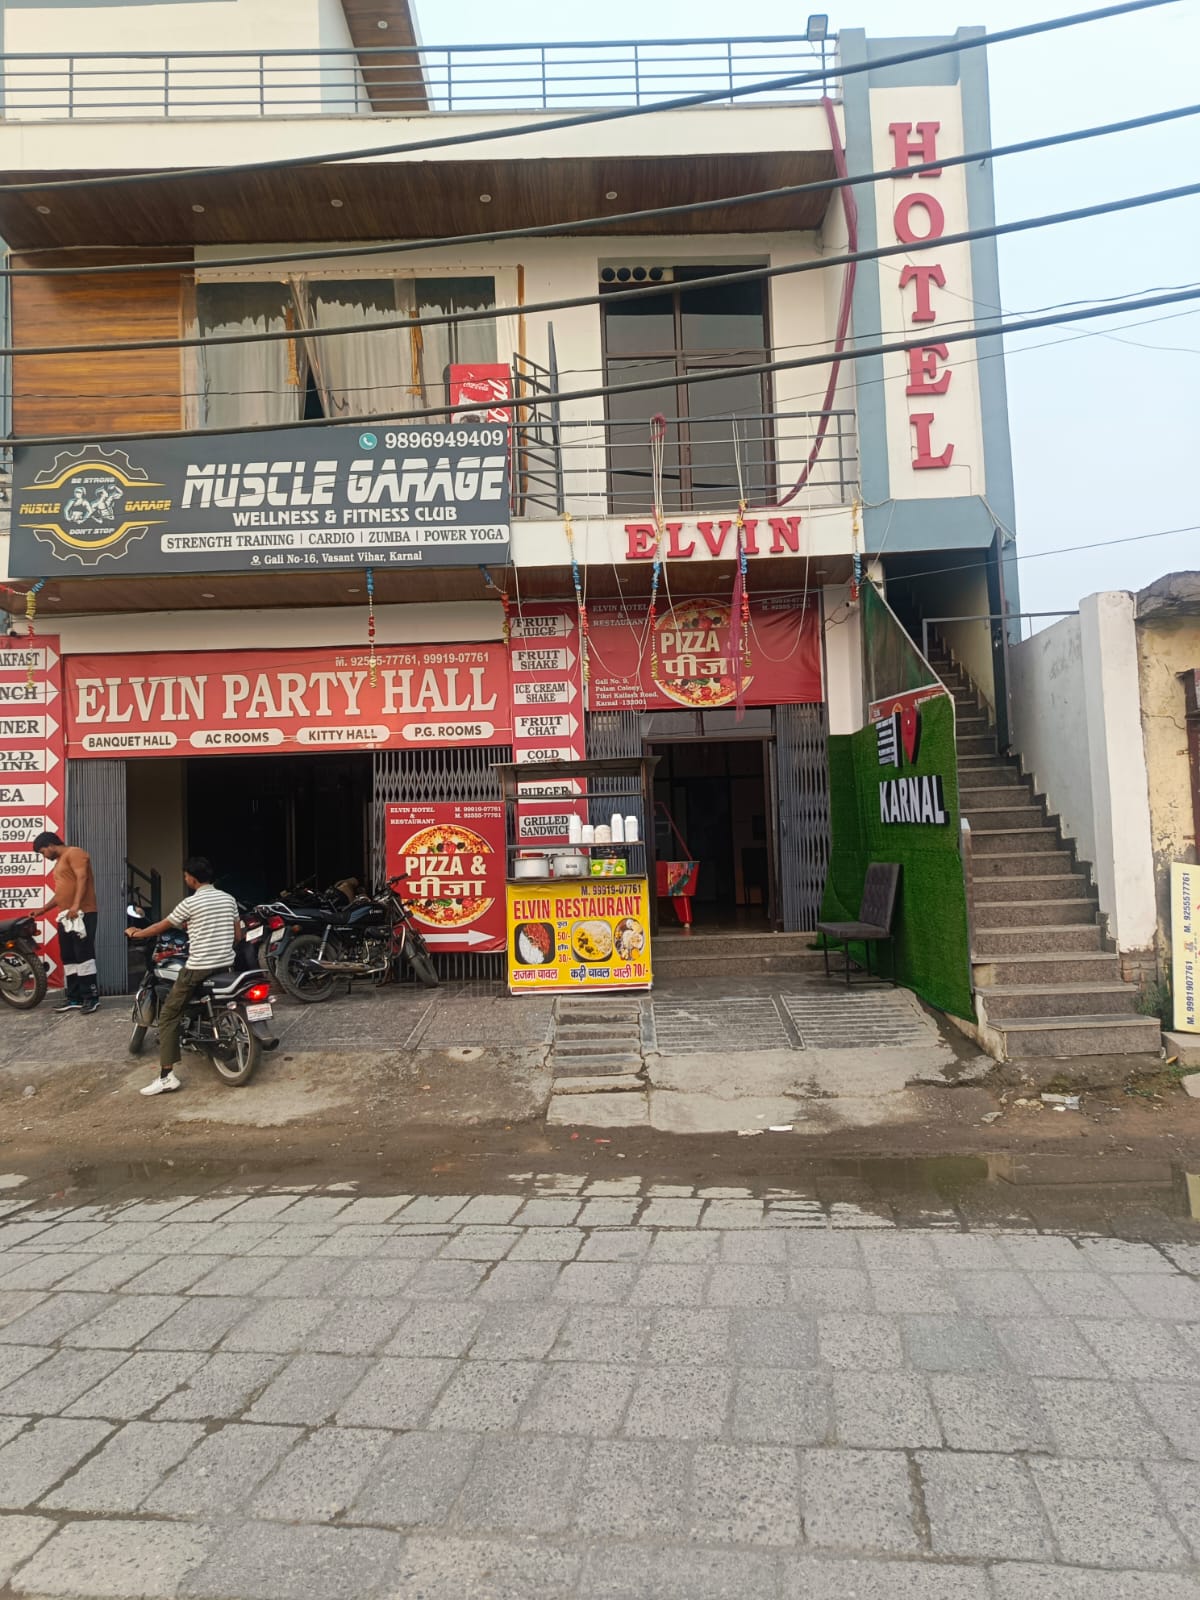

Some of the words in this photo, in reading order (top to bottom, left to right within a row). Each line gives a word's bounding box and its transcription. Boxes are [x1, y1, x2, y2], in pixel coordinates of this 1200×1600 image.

[889, 121, 954, 470] HOTEL
[385, 430, 504, 448] 9896949409
[181, 460, 338, 509] MUSCLE
[347, 456, 506, 504] GARAGE
[19, 503, 61, 514] MUSCLE
[124, 500, 172, 512] GARAGE
[232, 510, 319, 527] WELLNESS
[324, 510, 336, 524] &
[343, 508, 410, 525] FITNESS
[414, 506, 457, 522] CLUB
[166, 536, 232, 550] STRENGTH
[236, 534, 294, 548] TRAINING
[308, 532, 354, 545] CARDIO
[368, 531, 411, 544] ZUMBA
[424, 529, 466, 542] POWER
[470, 528, 504, 540] YOGA
[624, 517, 802, 560] ELVIN
[264, 555, 284, 565] Gali
[287, 554, 319, 564] No-16,
[322, 552, 354, 563] Vasant
[358, 551, 386, 562] Vihar,
[390, 550, 422, 561] Karnal
[516, 617, 558, 628] FRUIT
[520, 626, 557, 636] JUICE
[660, 630, 720, 654] PIZZA
[336, 656, 348, 667] M.
[424, 652, 489, 664] 99919-07761
[518, 650, 560, 660] FRUIT
[520, 660, 558, 670] SHAKE
[515, 684, 530, 694] ICE
[533, 683, 566, 692] CREAM
[75, 675, 207, 723] ELVIN
[222, 673, 367, 719] PARTY
[381, 668, 497, 714] HALL
[526, 694, 556, 703] SHAKE
[520, 716, 563, 727] FRUIT
[308, 730, 344, 741] KITTY
[346, 728, 378, 740] HALL
[414, 726, 435, 738] P.G.
[438, 725, 482, 736] ROOMS
[527, 726, 557, 736] CHAT
[88, 736, 141, 748] BANQUET
[143, 734, 172, 746] HALL
[204, 734, 222, 744] AC
[224, 732, 270, 744] ROOMS
[527, 750, 560, 760] COLD
[880, 776, 945, 824] KARNAL
[524, 816, 568, 826] GRILLED
[10, 853, 42, 864] HALL
[405, 856, 464, 876] PIZZA
[470, 855, 487, 876] &
[406, 876, 486, 897] पीजा
[581, 886, 590, 896] M.
[513, 899, 550, 920] ELVIN
[555, 896, 641, 918] RESTAURANT
[512, 968, 536, 980] राजमा
[538, 968, 558, 980] चावल
[588, 968, 610, 978] चावल
[613, 964, 632, 979] थाली
[633, 963, 648, 978] 70/-
